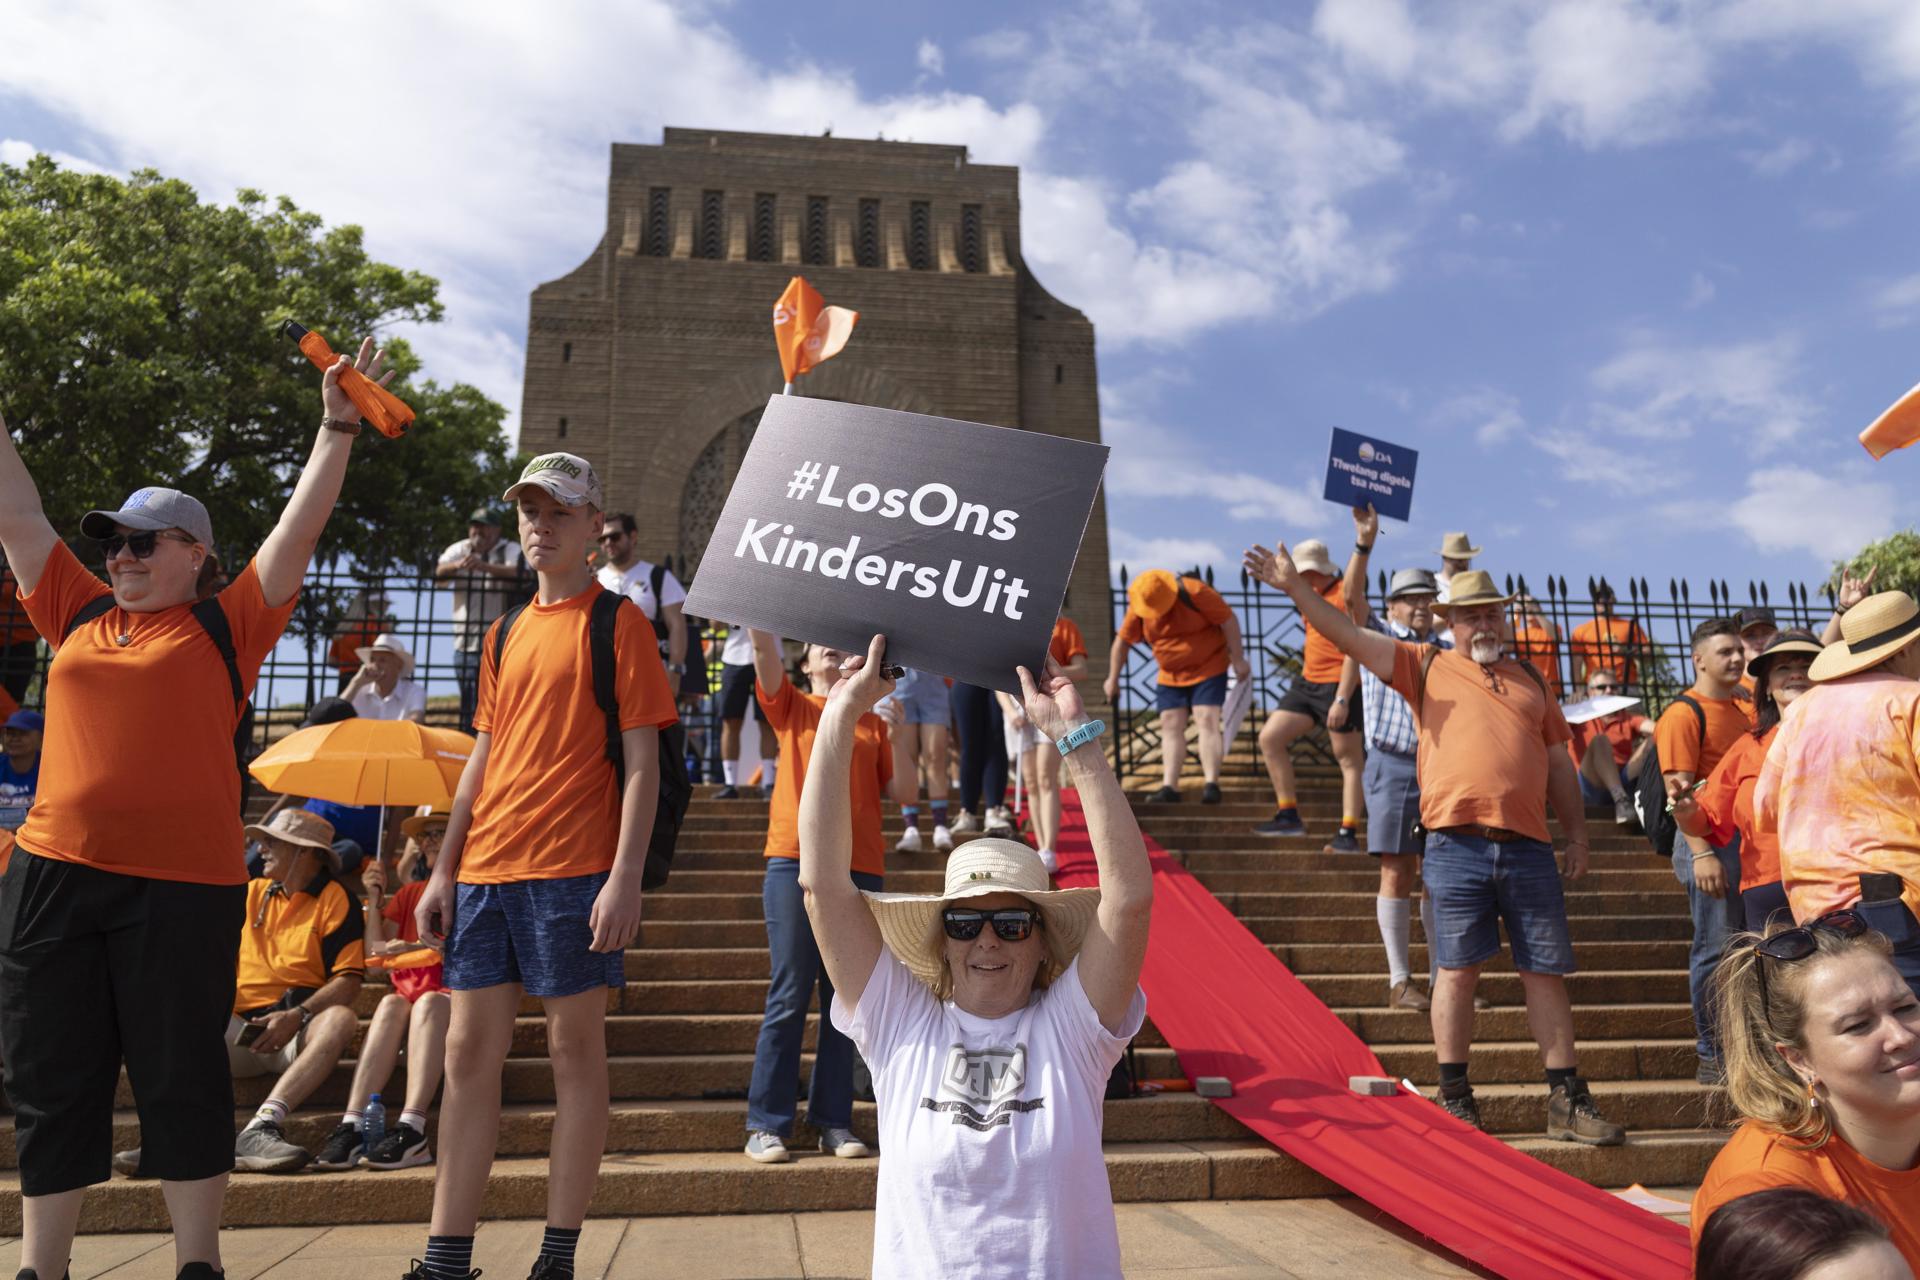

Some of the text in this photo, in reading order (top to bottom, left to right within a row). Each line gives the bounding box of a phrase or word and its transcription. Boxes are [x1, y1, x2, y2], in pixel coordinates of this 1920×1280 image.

[1375, 451, 1392, 465] DA
[786, 460, 1020, 541] #LosOns
[1368, 481, 1393, 496] rona
[734, 518, 1030, 621] KindersUit
